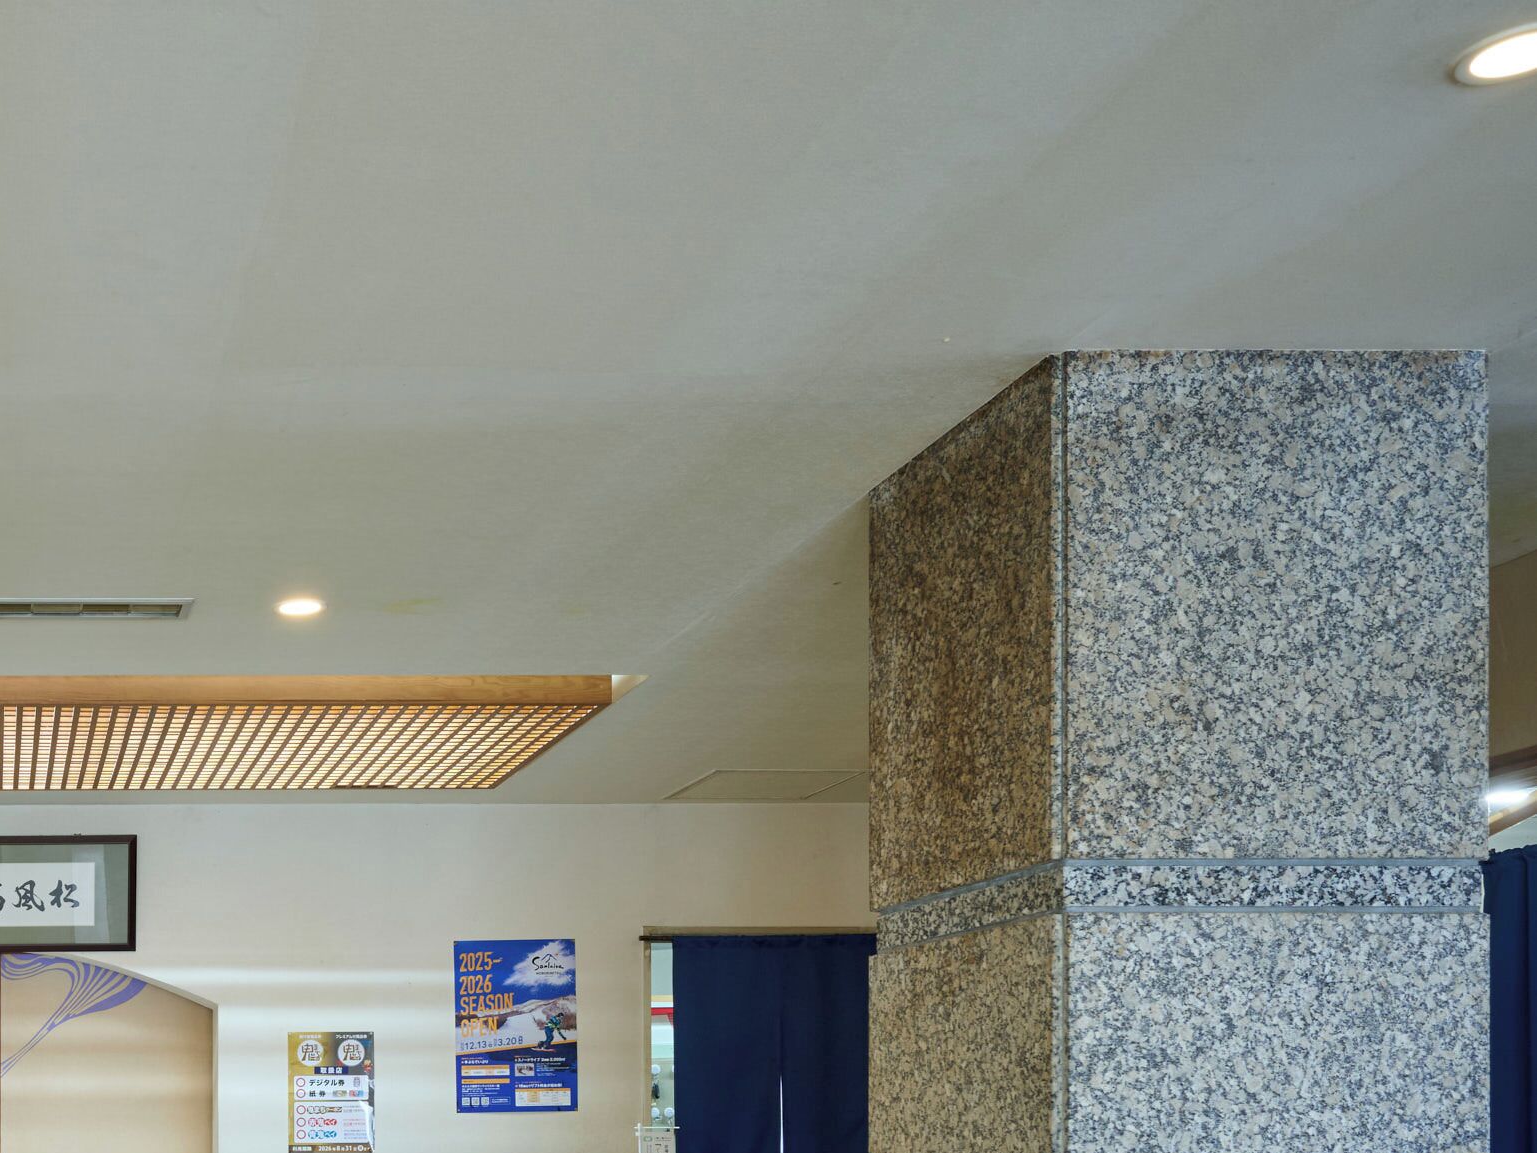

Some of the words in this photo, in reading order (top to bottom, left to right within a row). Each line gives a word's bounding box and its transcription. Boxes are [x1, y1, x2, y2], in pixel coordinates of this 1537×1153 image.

[459, 974, 492, 995] 2026
[460, 992, 514, 1016] SEASON
[461, 1016, 499, 1038] OPEN
[309, 1079, 345, 1087] デジタル券
